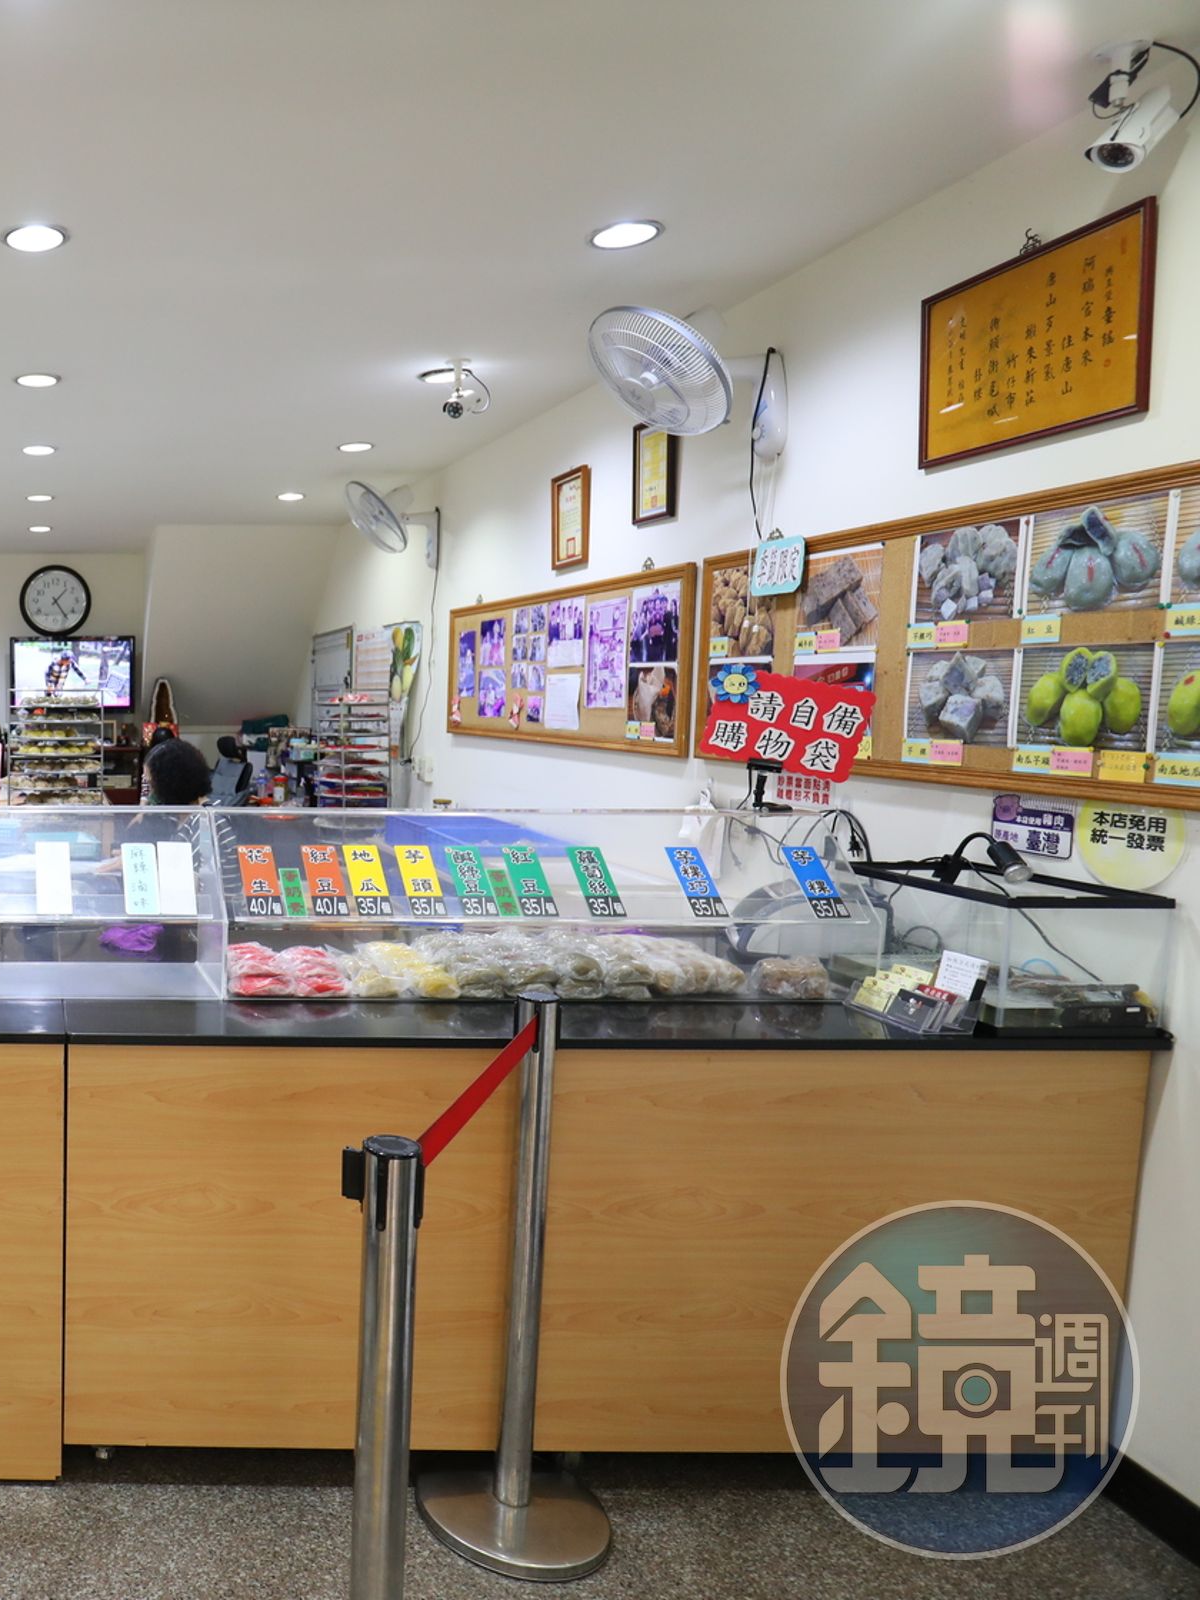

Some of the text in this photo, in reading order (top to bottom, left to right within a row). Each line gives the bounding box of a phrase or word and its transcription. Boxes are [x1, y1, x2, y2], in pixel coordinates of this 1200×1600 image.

[1174, 615, 1200, 626] 鹹綠
[750, 692, 861, 736] 請自備
[711, 721, 838, 771] 購物袋
[1090, 828, 1166, 852] 統一發票
[246, 849, 273, 894] 花生
[309, 849, 339, 894] 紅豆
[351, 850, 382, 893] 地瓜
[405, 850, 435, 893] 芋頭
[511, 849, 544, 895] 紅豆
